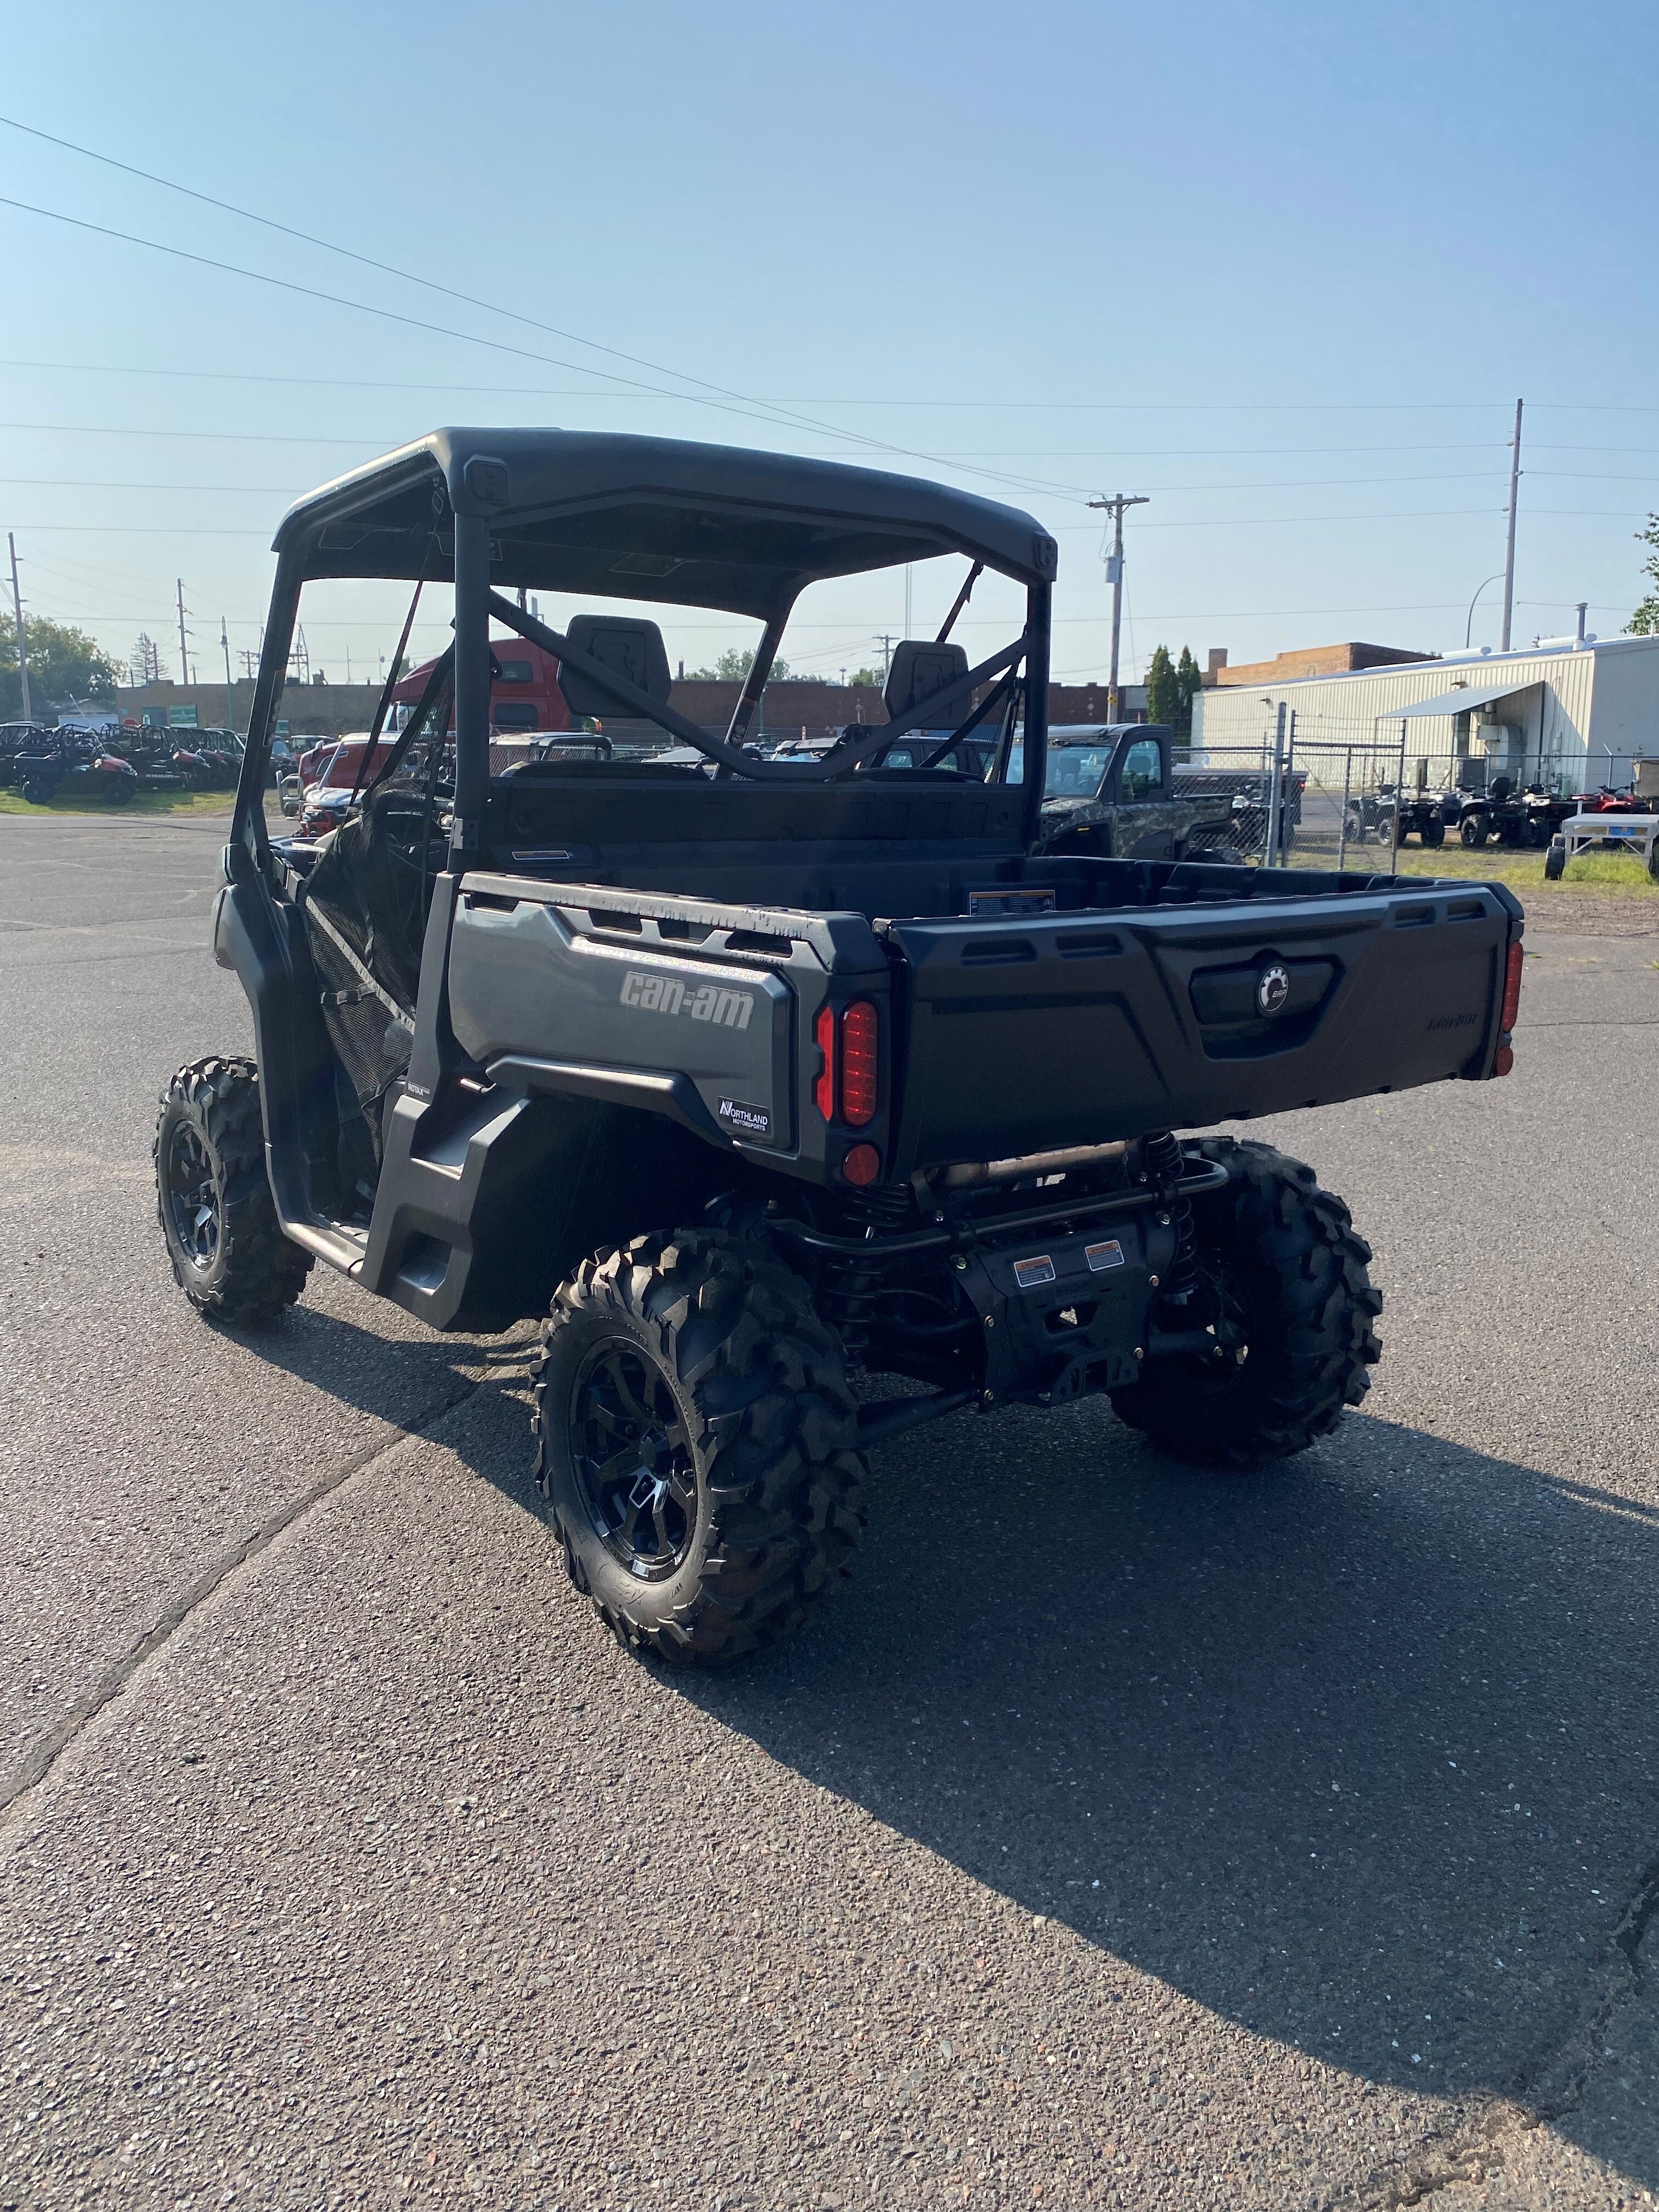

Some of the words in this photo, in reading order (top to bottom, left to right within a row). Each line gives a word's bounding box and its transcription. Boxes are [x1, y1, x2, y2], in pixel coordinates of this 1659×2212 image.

[1272, 989, 1286, 998] BRP
[620, 972, 753, 1030] can-am
[408, 1082, 424, 1096] ROTAX
[732, 1118, 766, 1131] MOTORSPORTS
